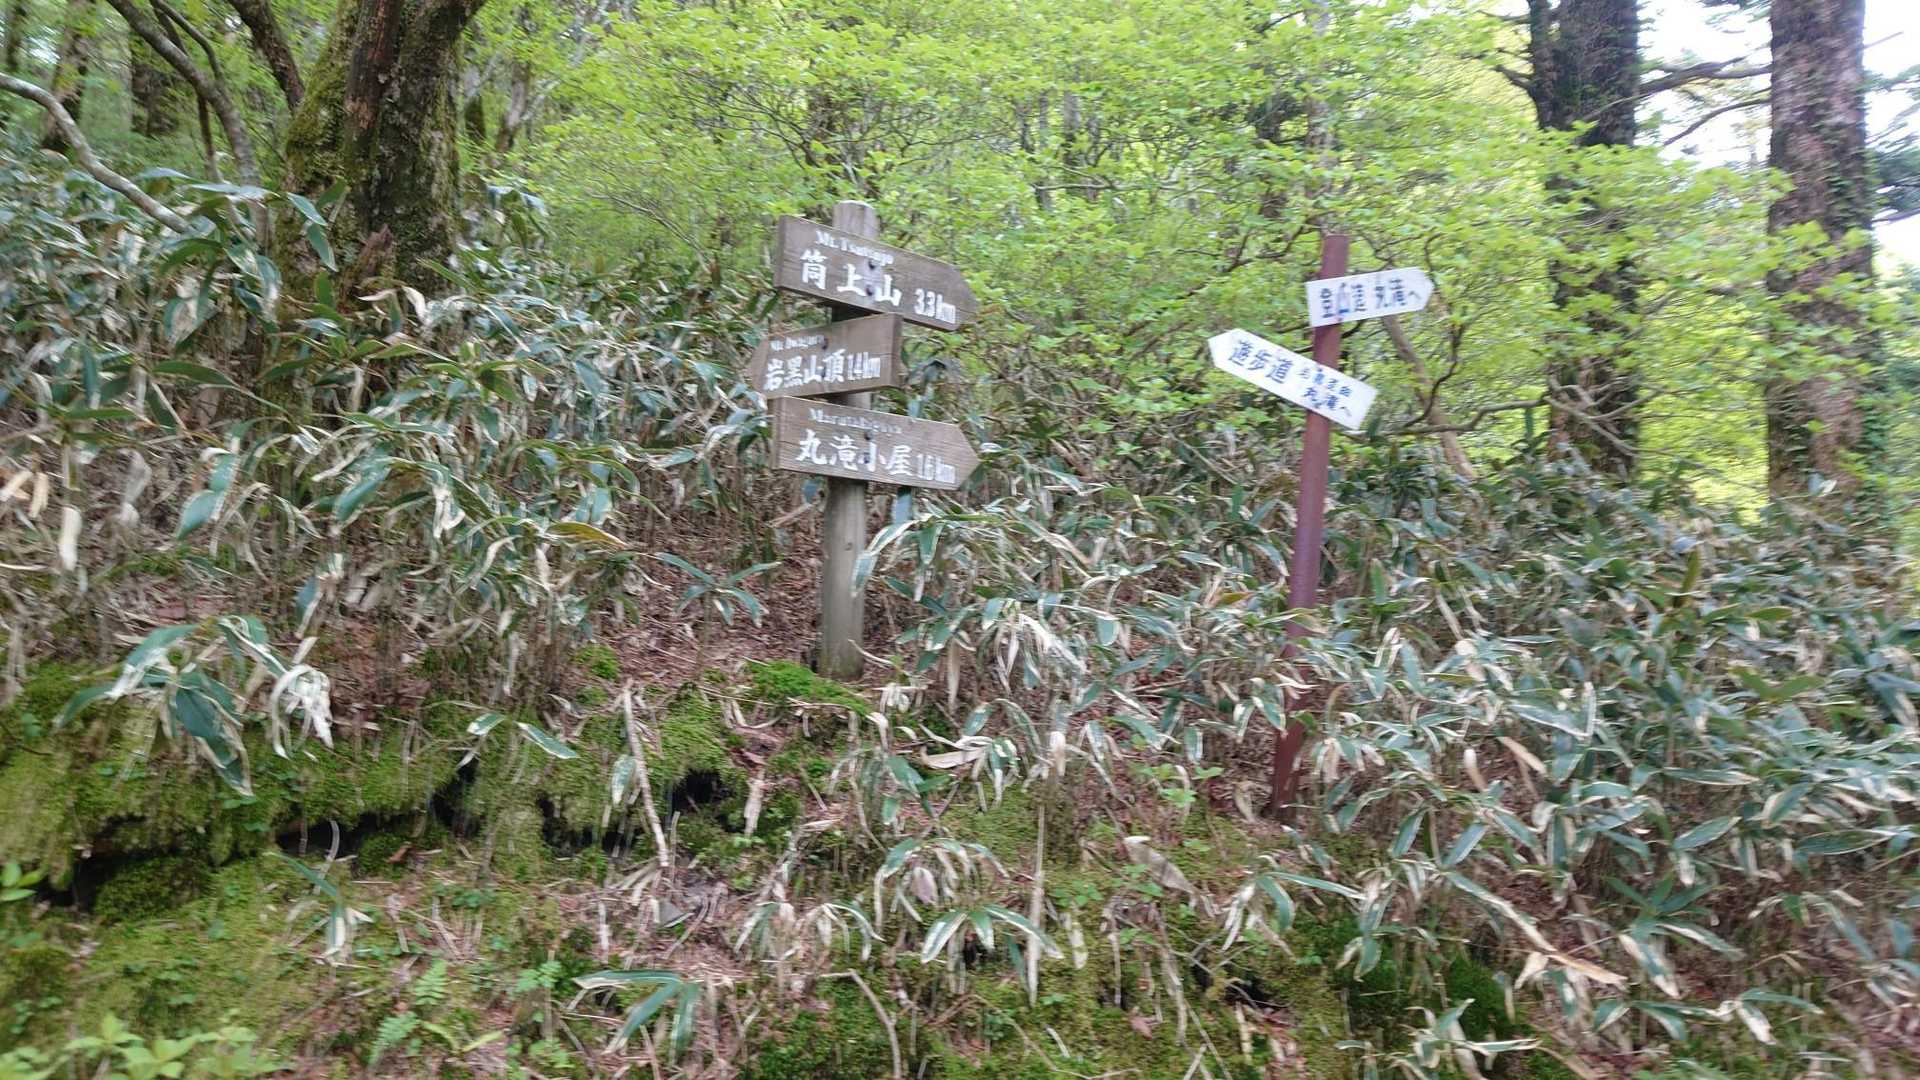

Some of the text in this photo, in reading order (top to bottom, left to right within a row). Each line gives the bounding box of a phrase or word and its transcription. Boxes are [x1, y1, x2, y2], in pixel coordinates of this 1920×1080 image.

[800, 249, 902, 307] 筒上山
[764, 349, 846, 391] 岩黒山頂
[1229, 339, 1294, 385] 遊歩道
[795, 428, 913, 477] 丸滝小屋
